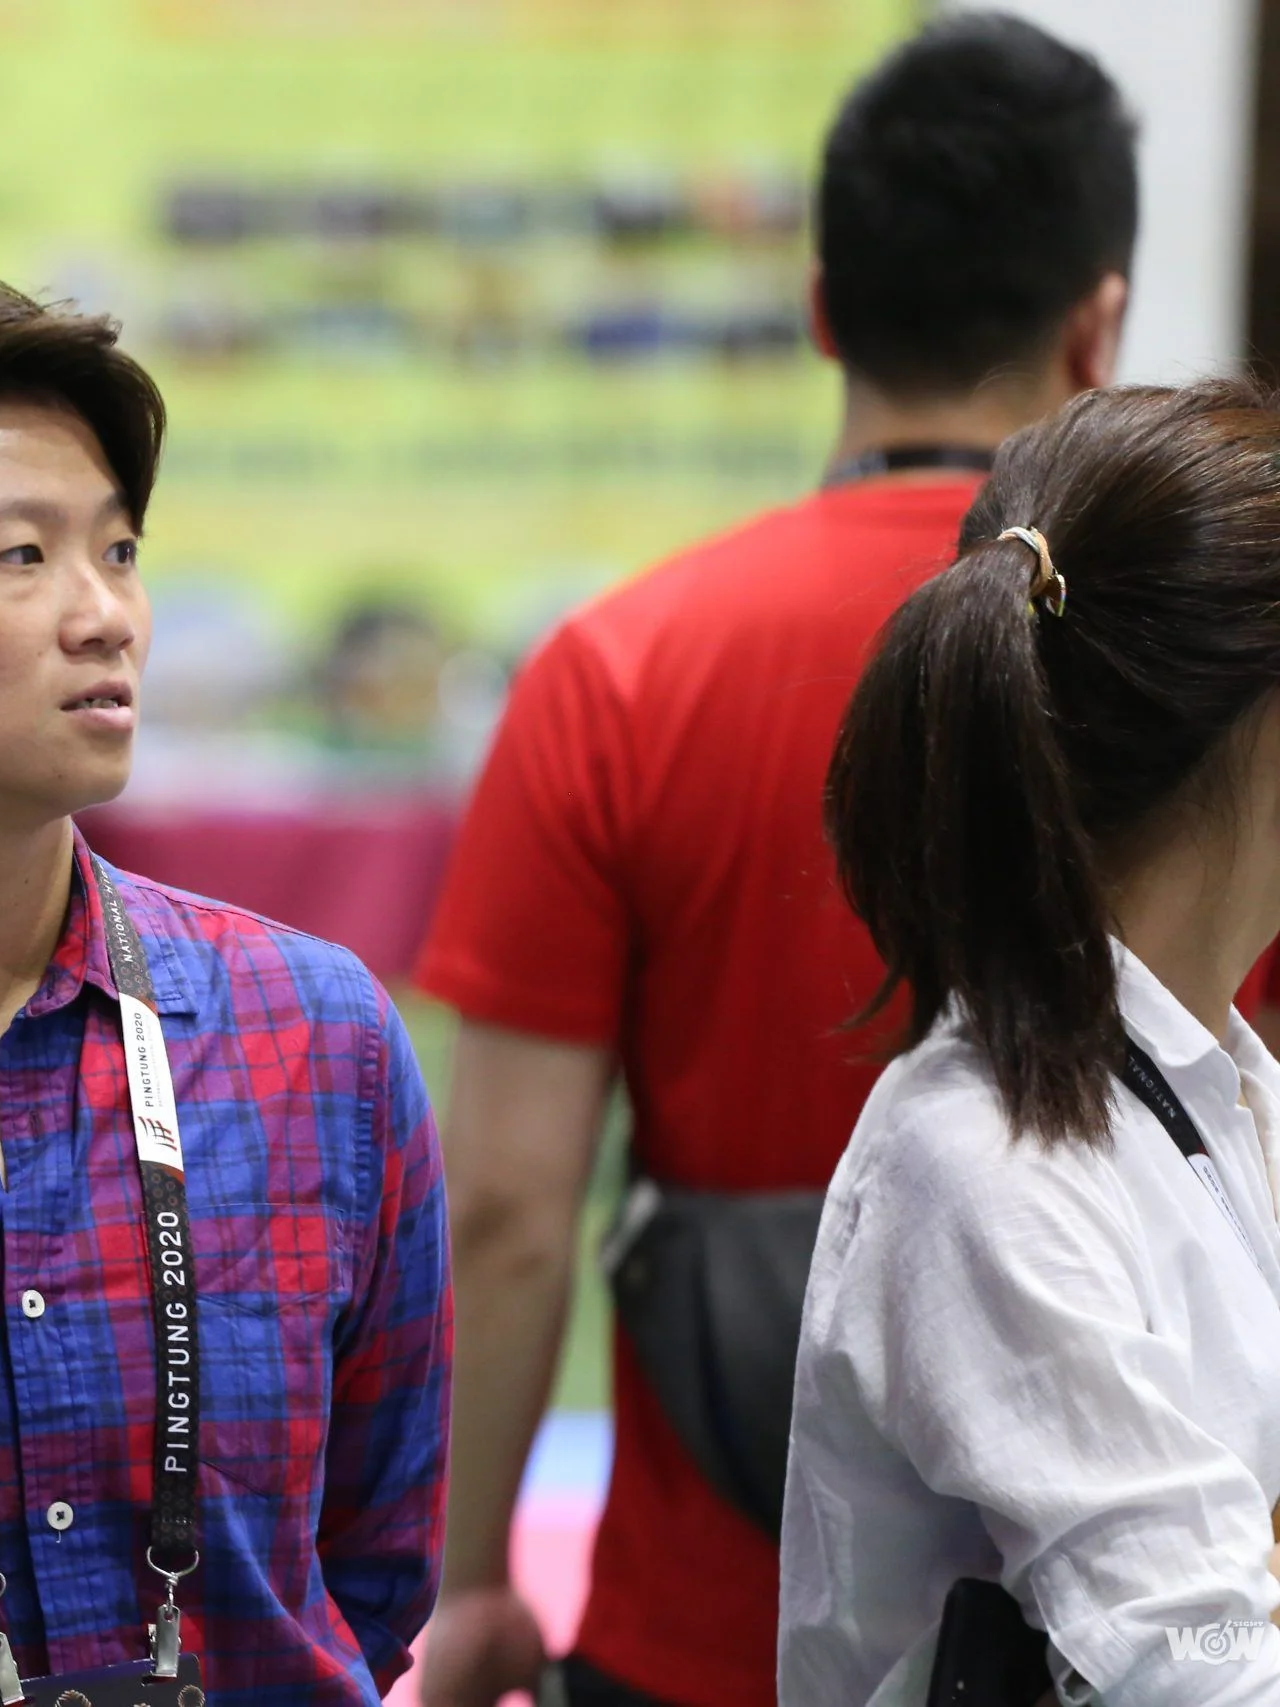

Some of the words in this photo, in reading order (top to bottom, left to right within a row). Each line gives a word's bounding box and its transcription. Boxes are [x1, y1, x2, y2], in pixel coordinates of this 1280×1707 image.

[100, 863, 113, 894] HIG
[110, 900, 133, 962] NATIONAL
[134, 1012, 146, 1041] 2020
[138, 1046, 154, 1108] PINGTUNG
[1128, 1057, 1177, 1119] NATIONAL
[157, 1211, 186, 1287] 2020
[164, 1302, 190, 1473] PINGTUNG
